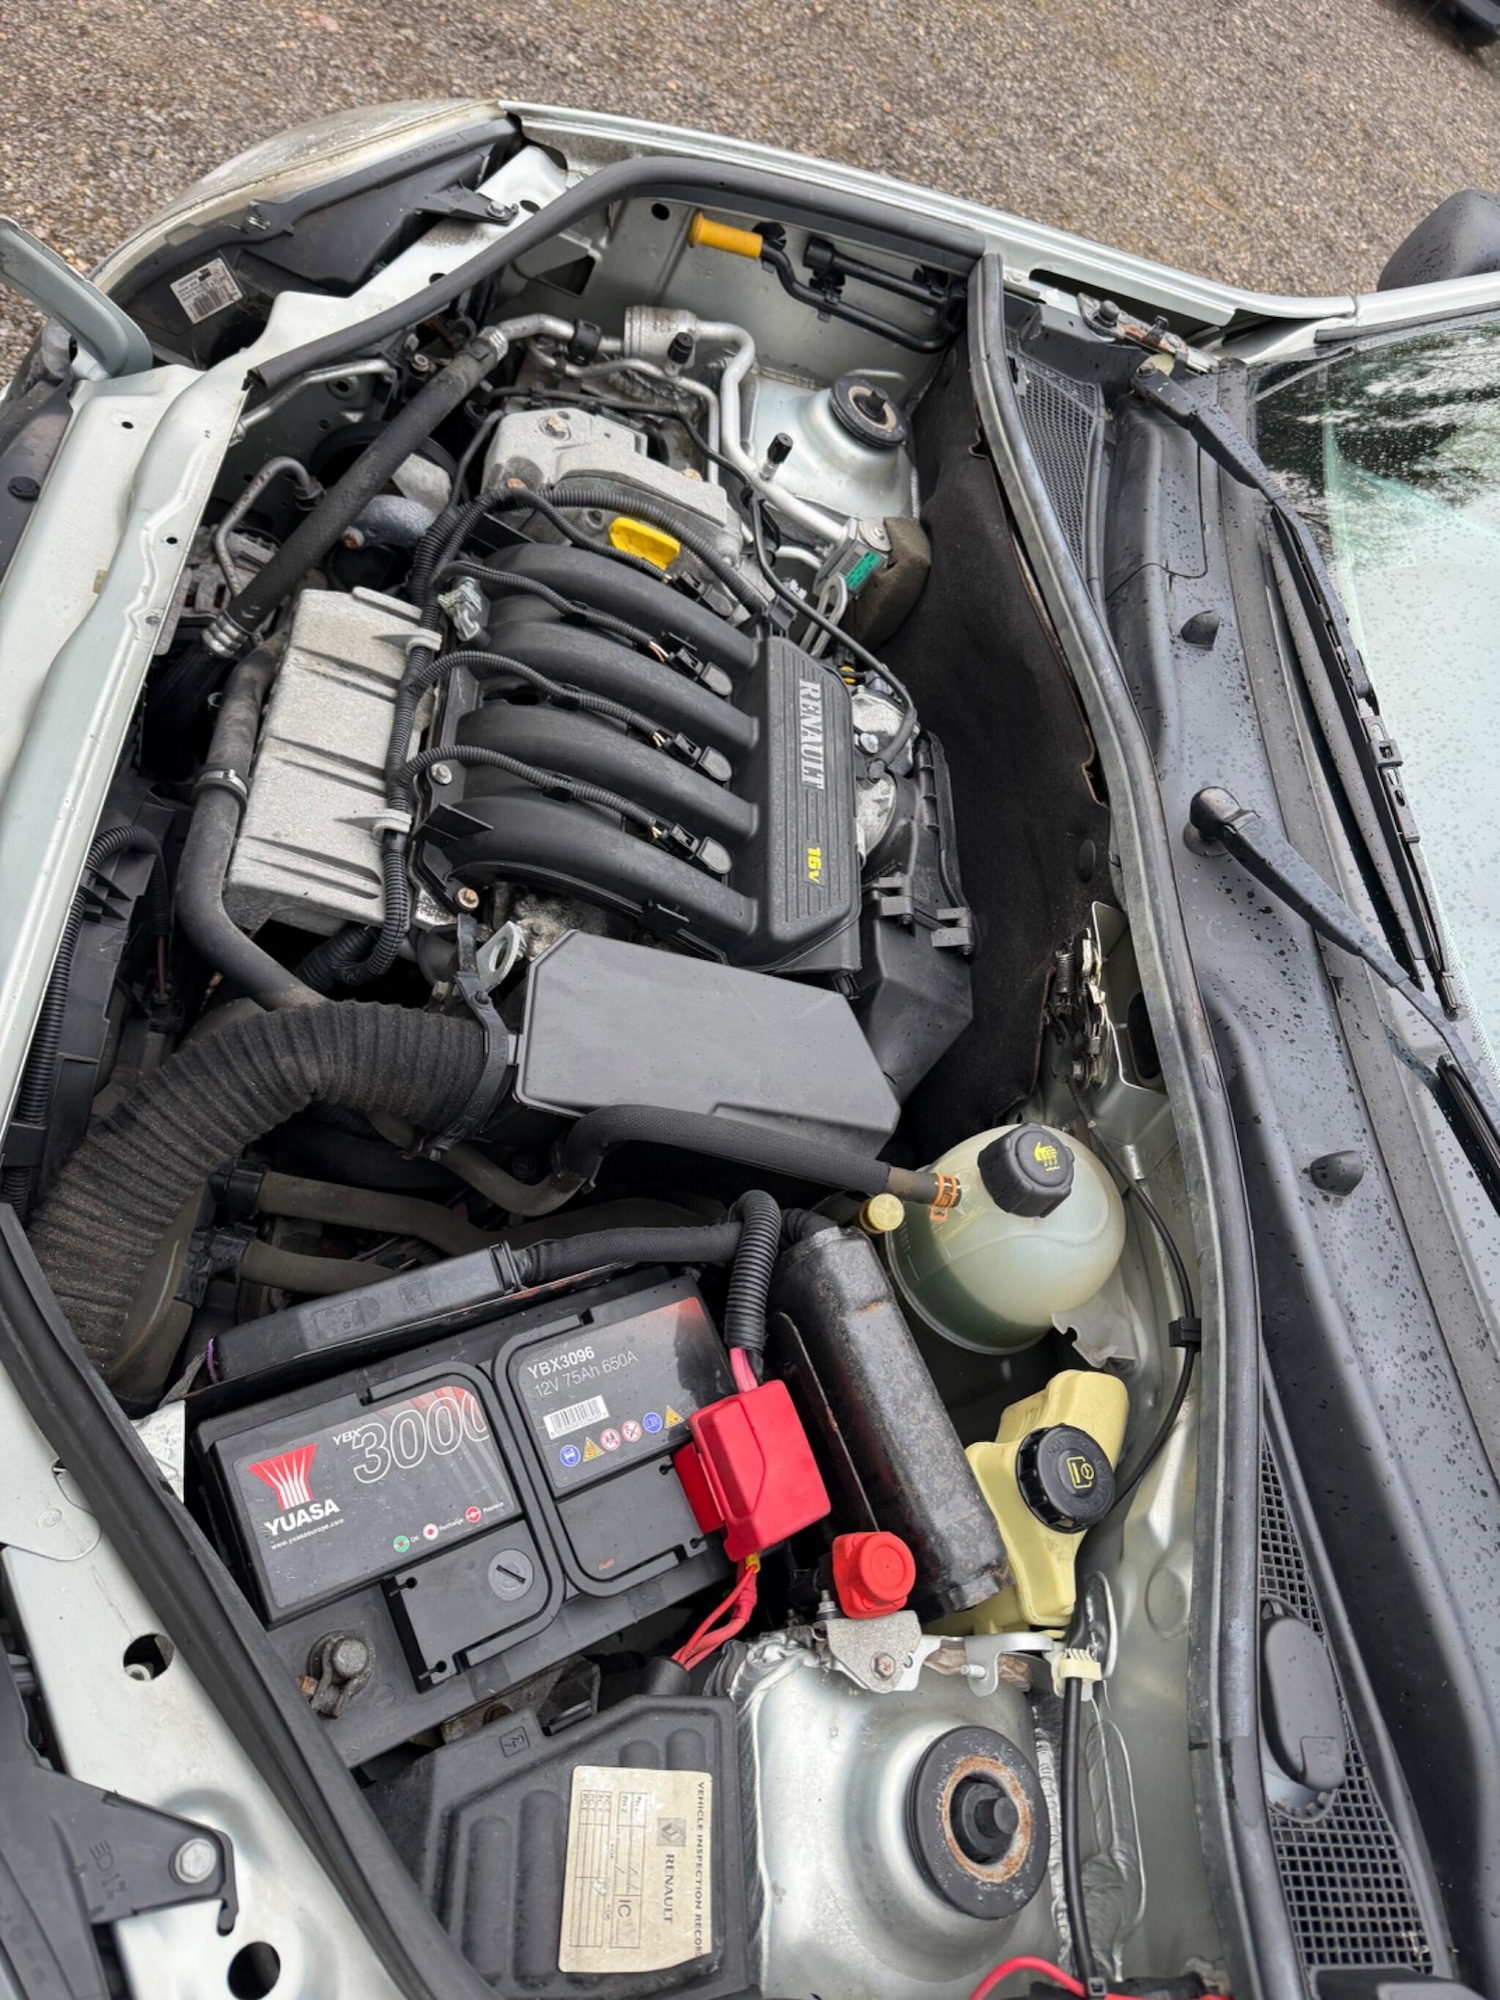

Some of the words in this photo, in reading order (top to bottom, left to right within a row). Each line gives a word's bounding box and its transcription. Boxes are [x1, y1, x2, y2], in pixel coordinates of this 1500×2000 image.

[800, 678, 825, 790] RENAULT
[527, 1346, 595, 1379] YBX3096
[534, 1377, 559, 1397] 12V
[563, 1364, 601, 1387] 75Ah
[602, 1350, 639, 1374] 650A
[332, 1427, 362, 1446] YBX
[263, 1498, 340, 1536] YUASA
[697, 1781, 705, 1831] VEHICLE
[663, 1854, 675, 1924] RENAULT
[694, 1834, 704, 1911] INSPECTION
[617, 1899, 632, 1918] IC
